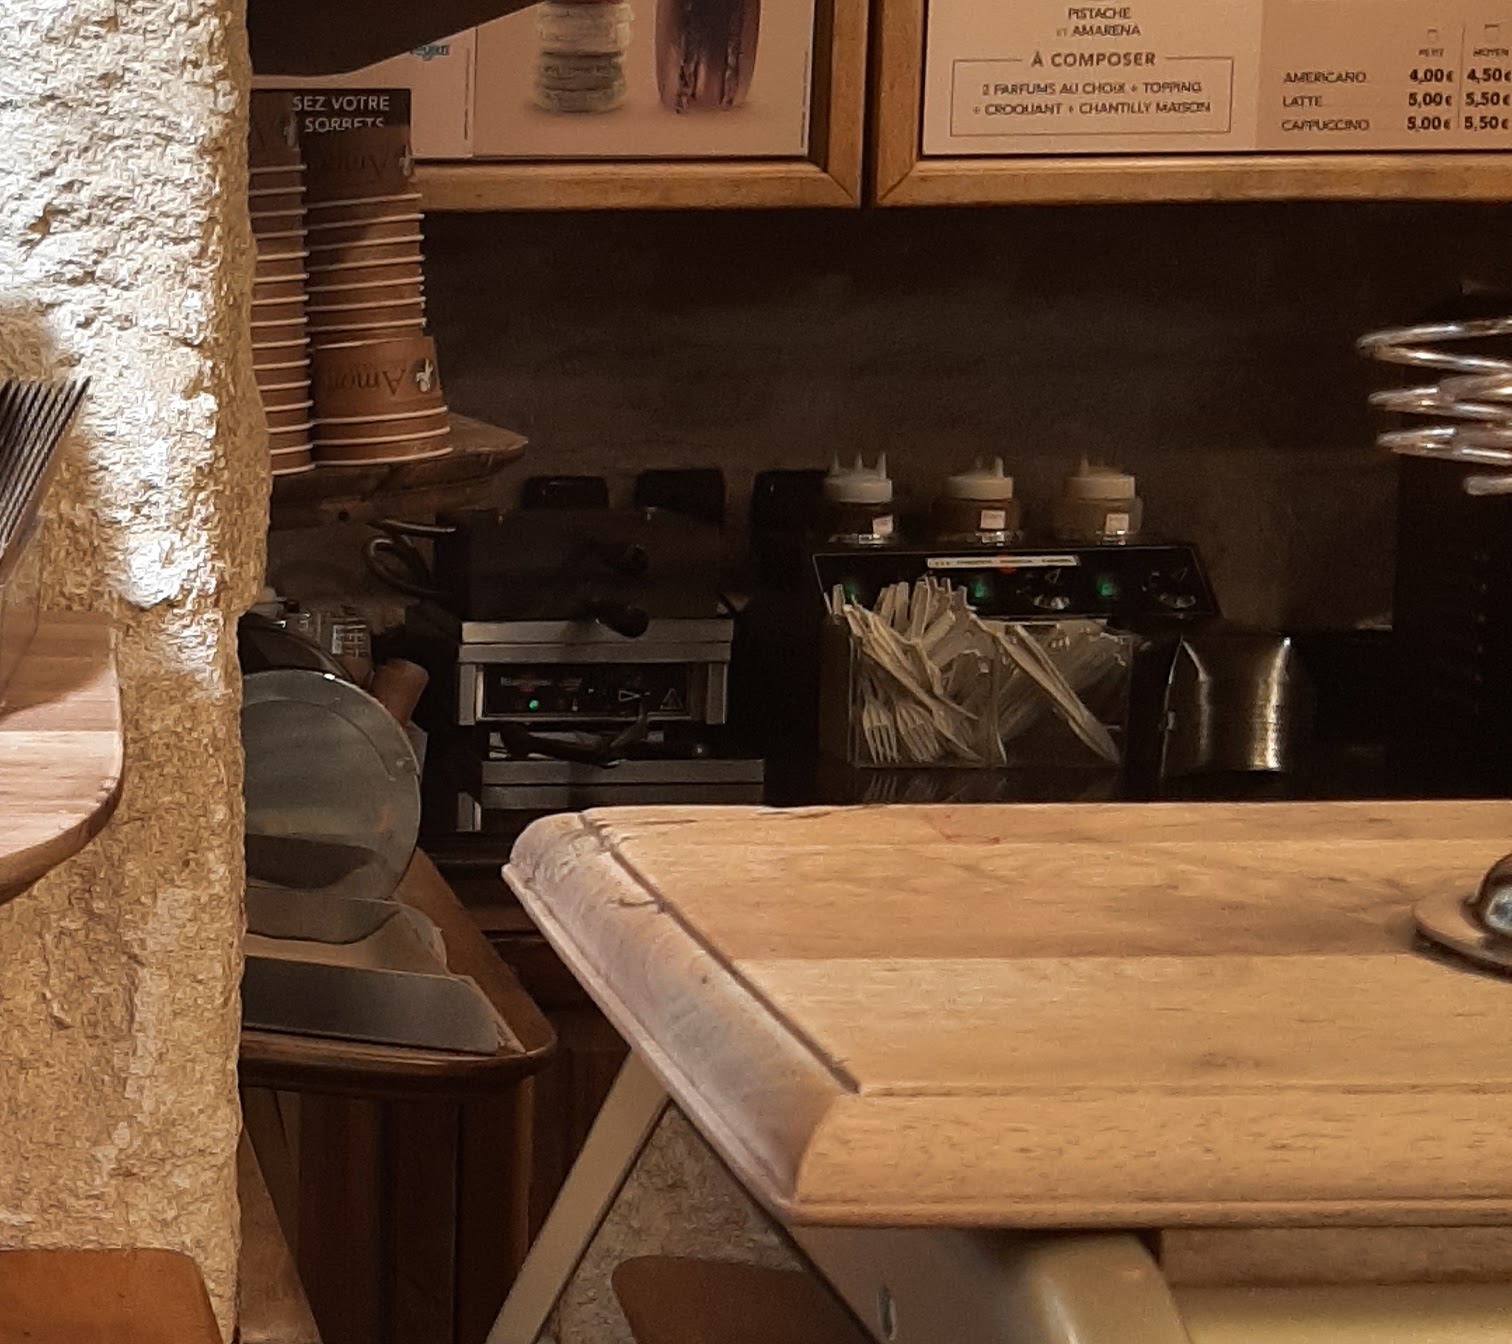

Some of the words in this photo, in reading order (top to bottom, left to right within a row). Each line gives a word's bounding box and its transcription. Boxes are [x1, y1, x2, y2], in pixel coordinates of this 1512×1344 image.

[1068, 7, 1131, 19] PISTACHE
[1072, 25, 1141, 37] AMARENA
[1050, 52, 1156, 67] COMPOSER
[1283, 71, 1367, 83] AMERICANO
[994, 83, 1057, 96] PARFUMS
[1060, 83, 1079, 95] AU
[1082, 82, 1125, 94] CHOIX
[1142, 81, 1202, 94] TOPPING
[292, 95, 328, 112] SEZ
[331, 95, 390, 112] VOTRE
[1282, 95, 1323, 107] LATTE
[984, 103, 1062, 116] CROQUANT
[1079, 102, 1151, 114] CHANTILLY
[1281, 119, 1370, 131] CAPPUCCINO
